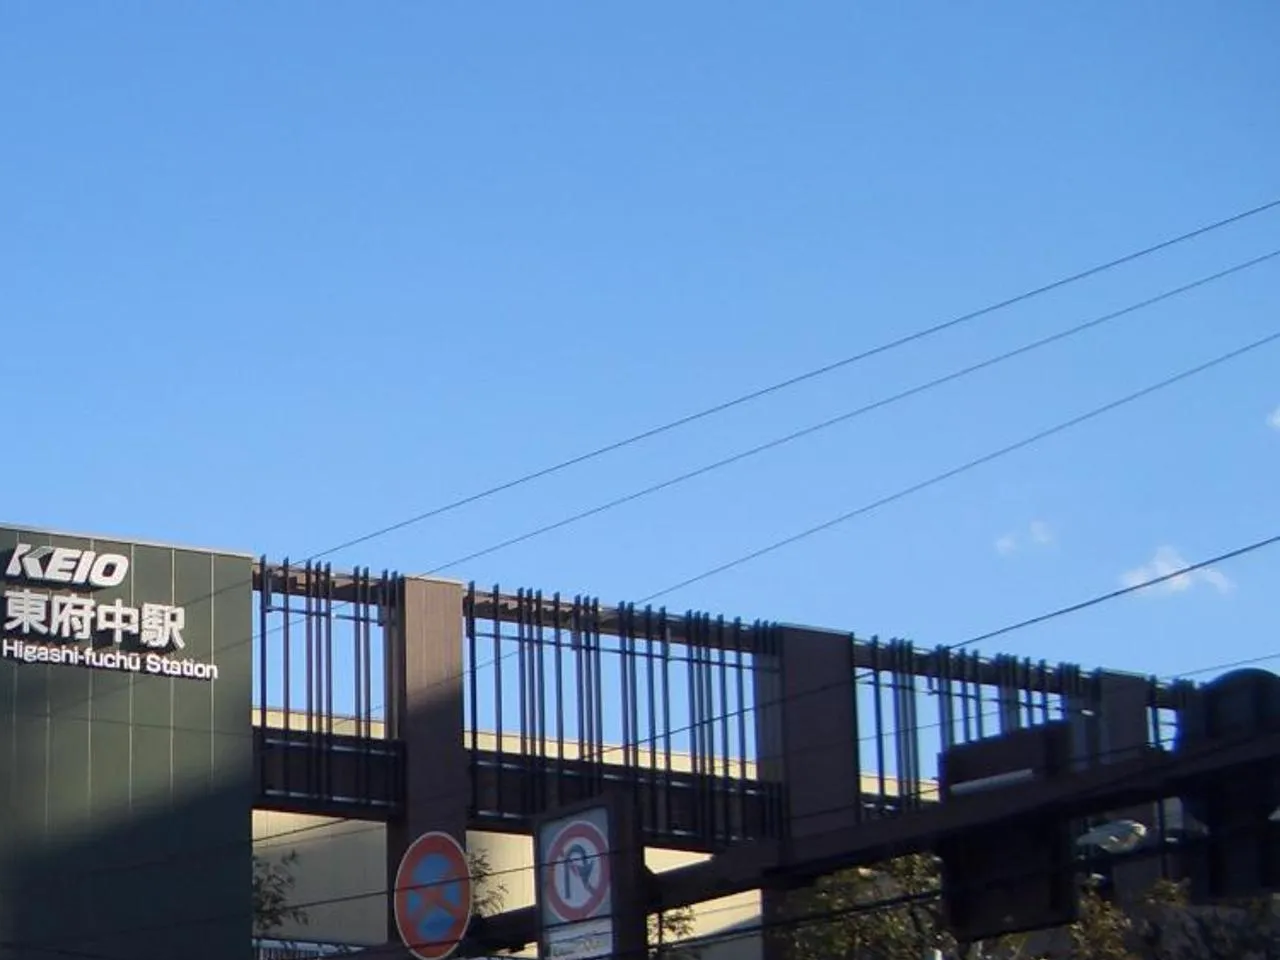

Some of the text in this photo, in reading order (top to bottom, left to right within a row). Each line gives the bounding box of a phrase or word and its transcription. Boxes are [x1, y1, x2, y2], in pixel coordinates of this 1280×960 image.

[5, 543, 129, 587] KEIO
[4, 590, 186, 649] 東府中駅
[146, 654, 218, 679] Station
